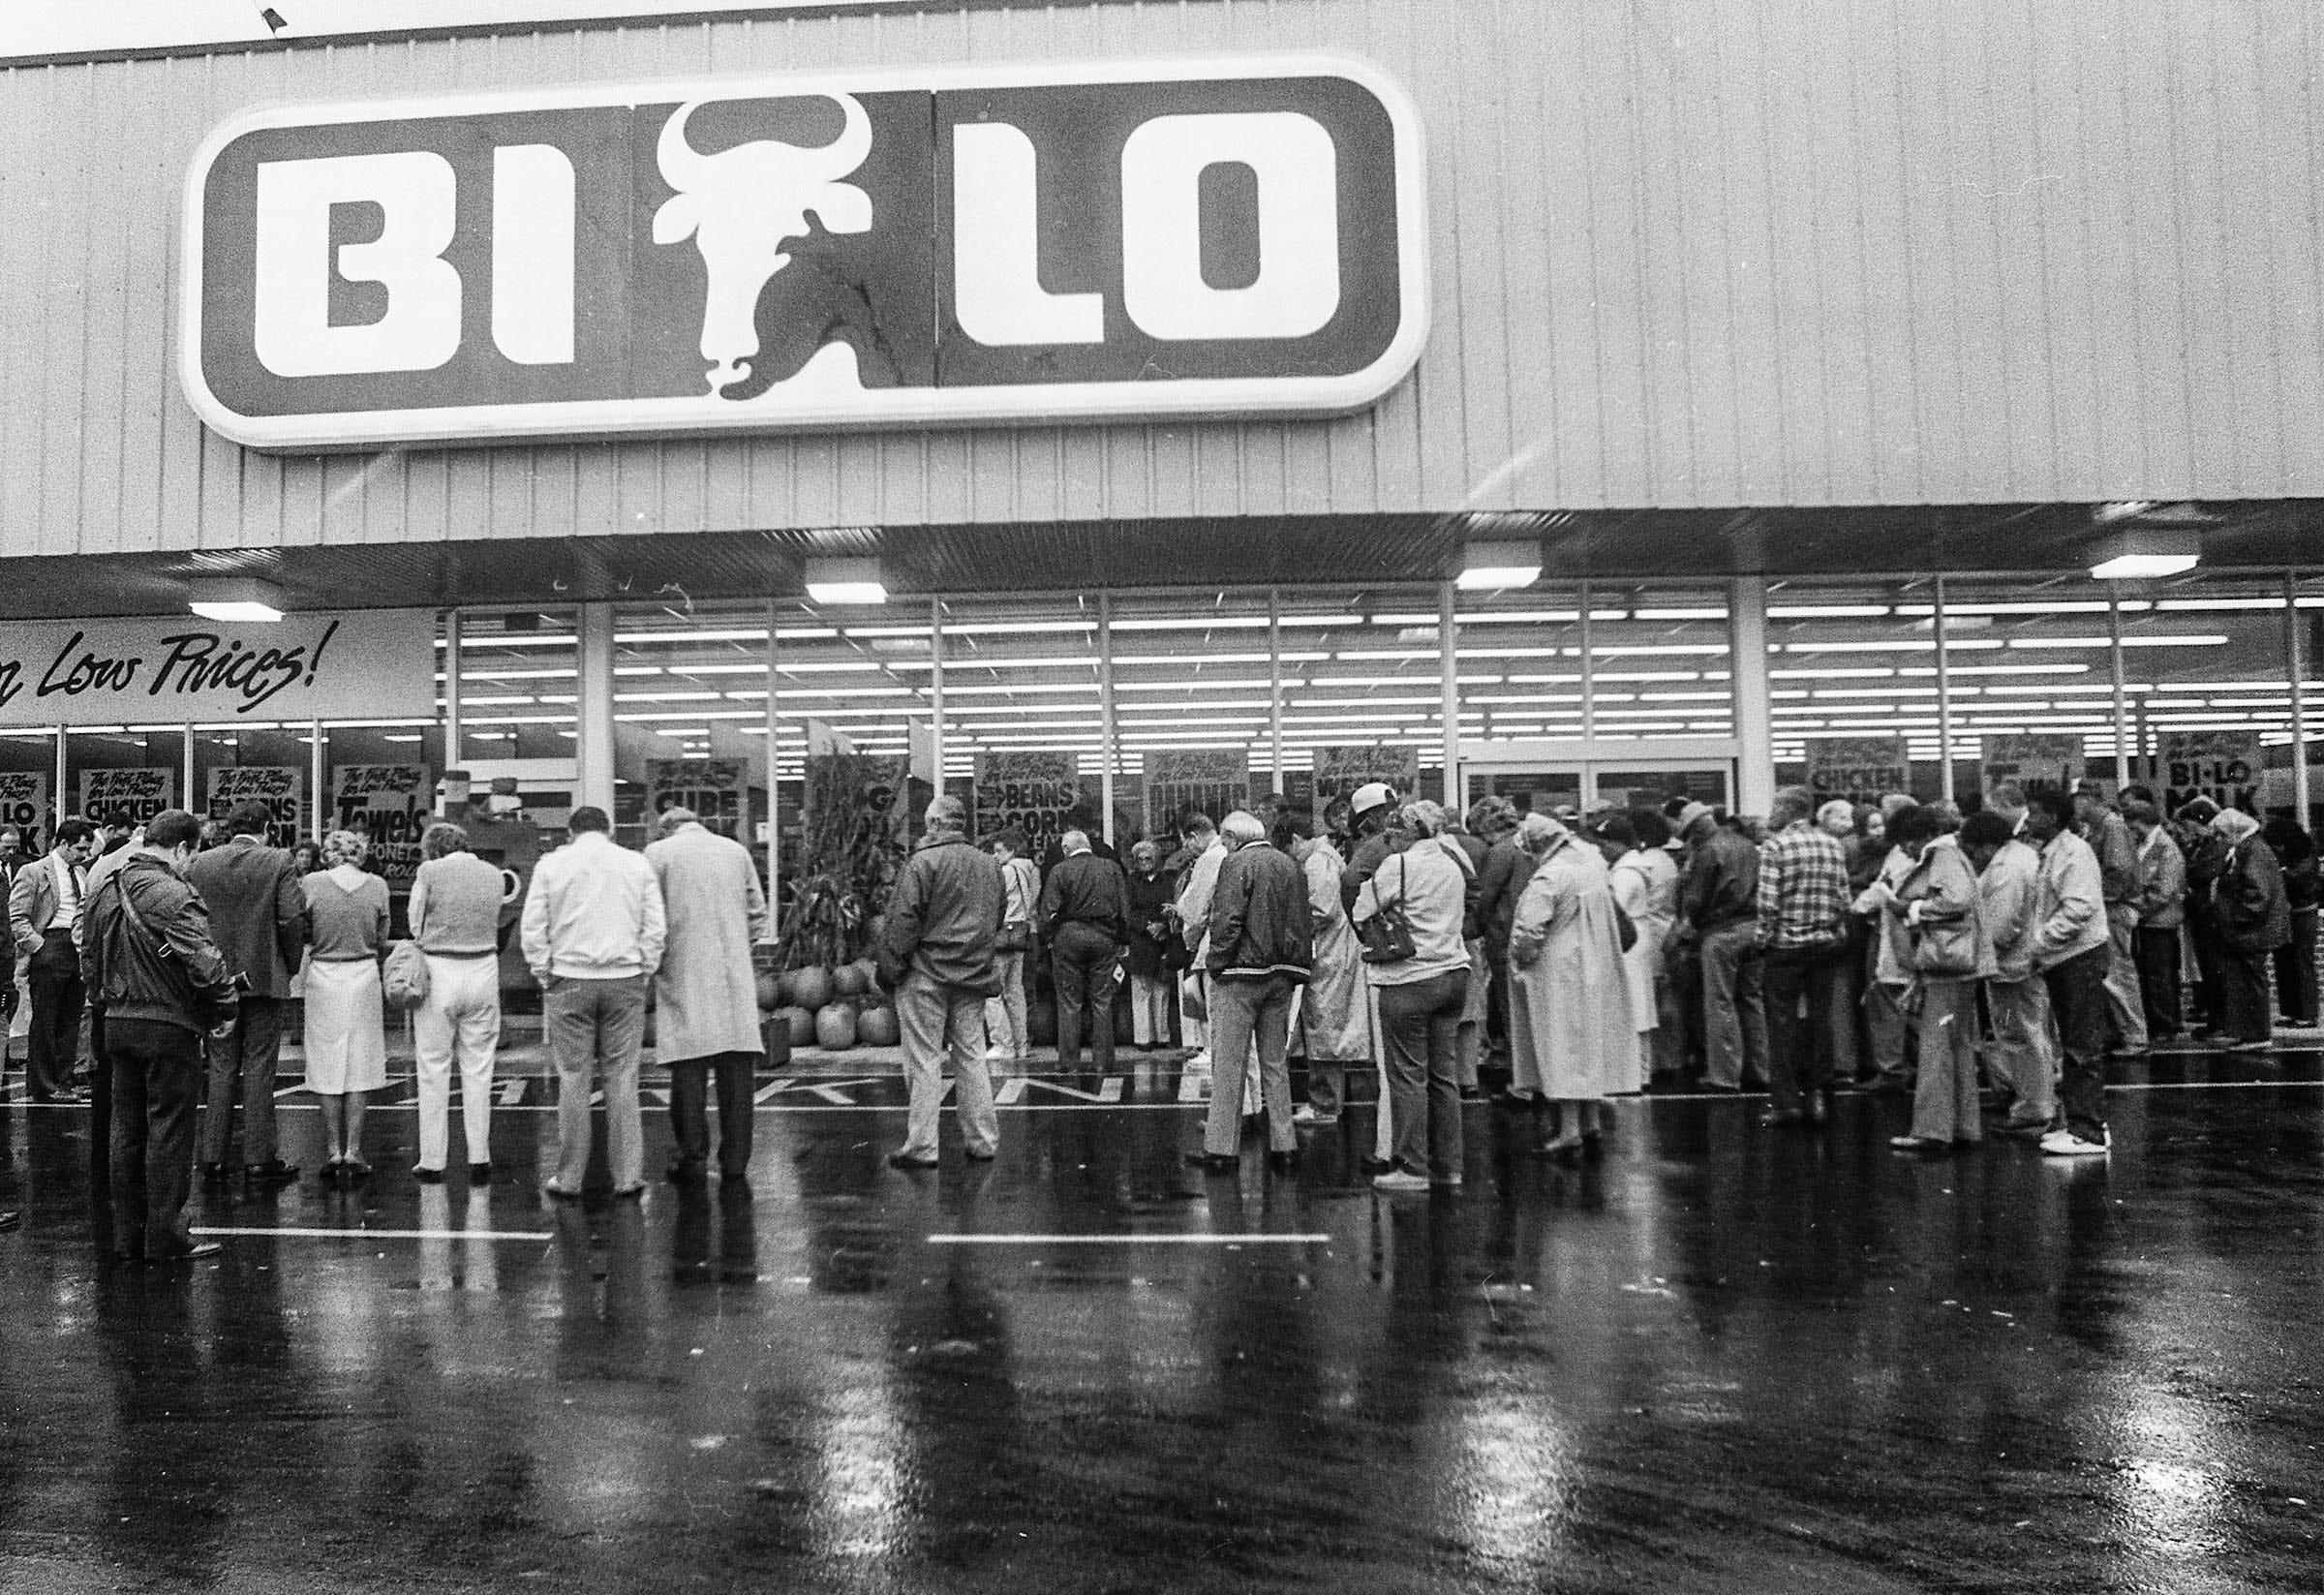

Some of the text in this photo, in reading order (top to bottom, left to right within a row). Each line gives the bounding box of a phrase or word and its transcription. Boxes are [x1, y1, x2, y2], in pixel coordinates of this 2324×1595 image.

[255, 110, 1341, 378] BI LO
[37, 631, 142, 696] Low
[149, 620, 339, 713] Prices!
[1006, 782, 1074, 808] BEANS
[1812, 767, 1905, 791] CHICKEN
